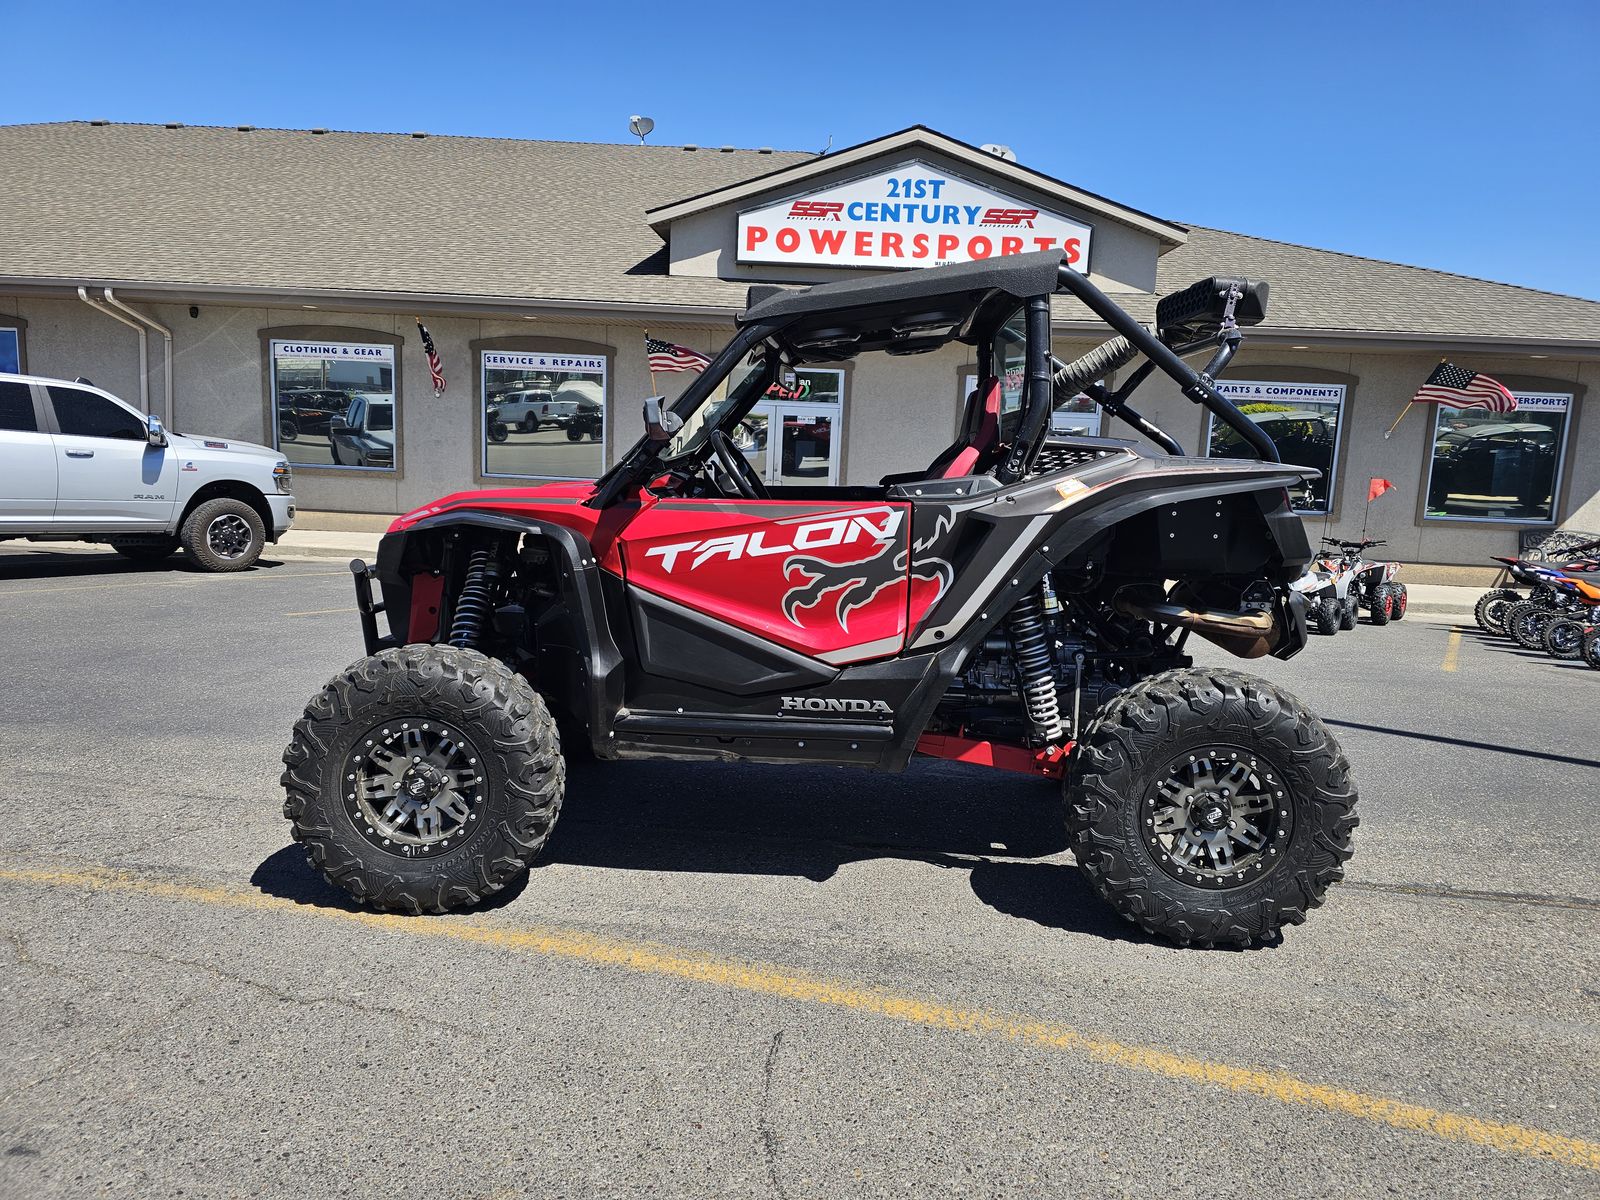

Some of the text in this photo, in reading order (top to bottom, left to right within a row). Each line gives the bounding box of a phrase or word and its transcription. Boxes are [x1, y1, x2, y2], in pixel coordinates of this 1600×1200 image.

[887, 178, 946, 200] 21ST
[788, 200, 845, 222] SSR
[847, 201, 982, 225] CENTURY
[980, 208, 1039, 229] SSR
[746, 226, 1081, 264] POWERSPORTS
[283, 345, 338, 355] CLOTHING
[354, 348, 383, 357] GEAR
[486, 356, 602, 368] SERVICE & REPAIRS
[1216, 385, 1251, 394] PARTS
[1266, 387, 1339, 397] COMPONENTS
[644, 510, 905, 574] TALON
[780, 696, 894, 714] HONDA
